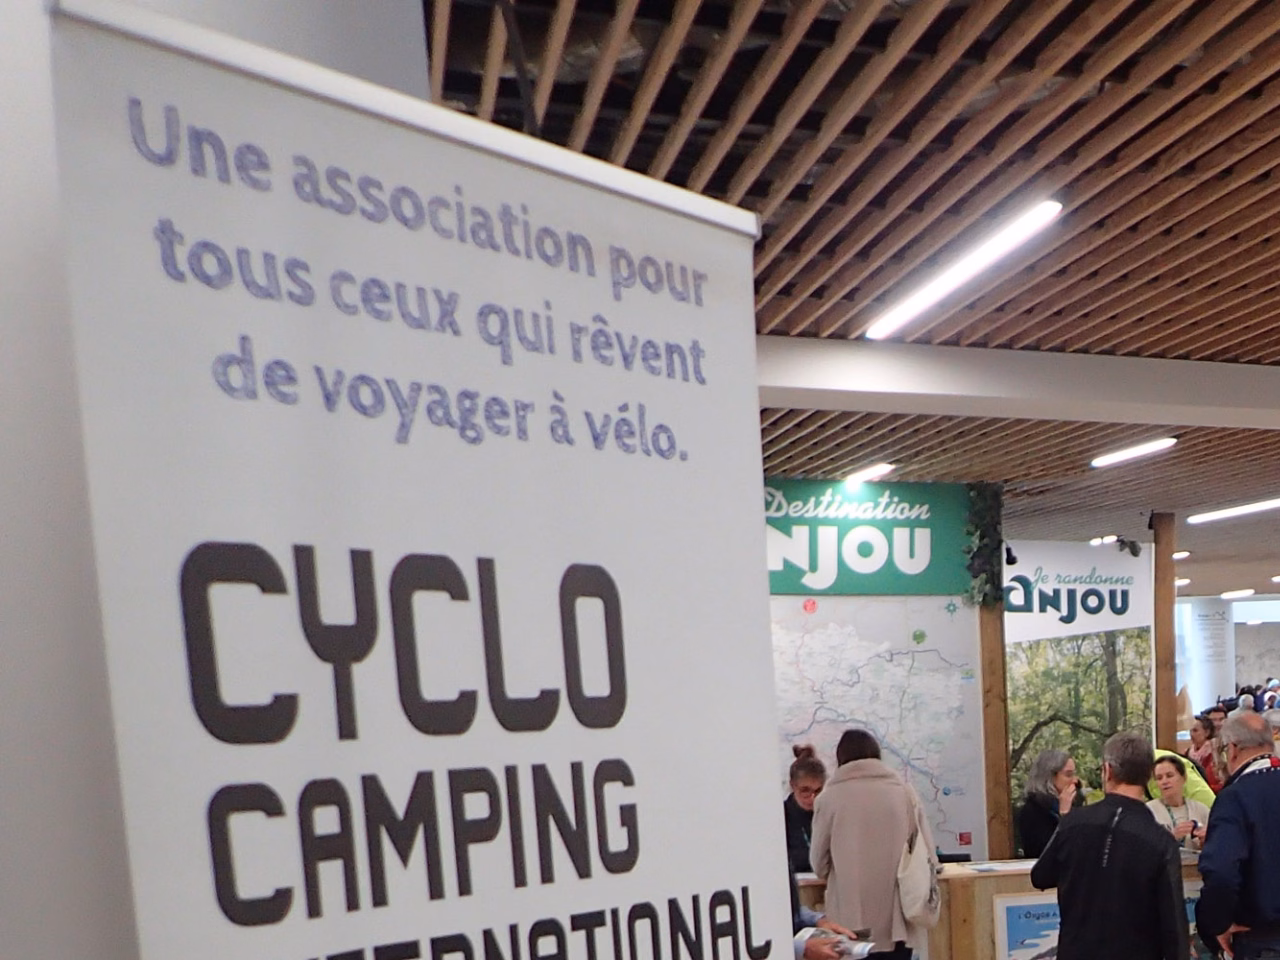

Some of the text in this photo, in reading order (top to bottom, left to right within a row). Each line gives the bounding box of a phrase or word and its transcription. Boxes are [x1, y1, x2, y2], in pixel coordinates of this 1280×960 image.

[128, 97, 708, 307] Une association pour
[154, 217, 707, 385] tous ceux qui rêvent
[212, 335, 690, 462] de voyager à vélo.
[766, 486, 931, 519] Destination
[766, 523, 931, 590] NJOU
[1055, 566, 1135, 586] randonne
[179, 541, 628, 745] CYCLO
[207, 758, 641, 927] CAMPING
